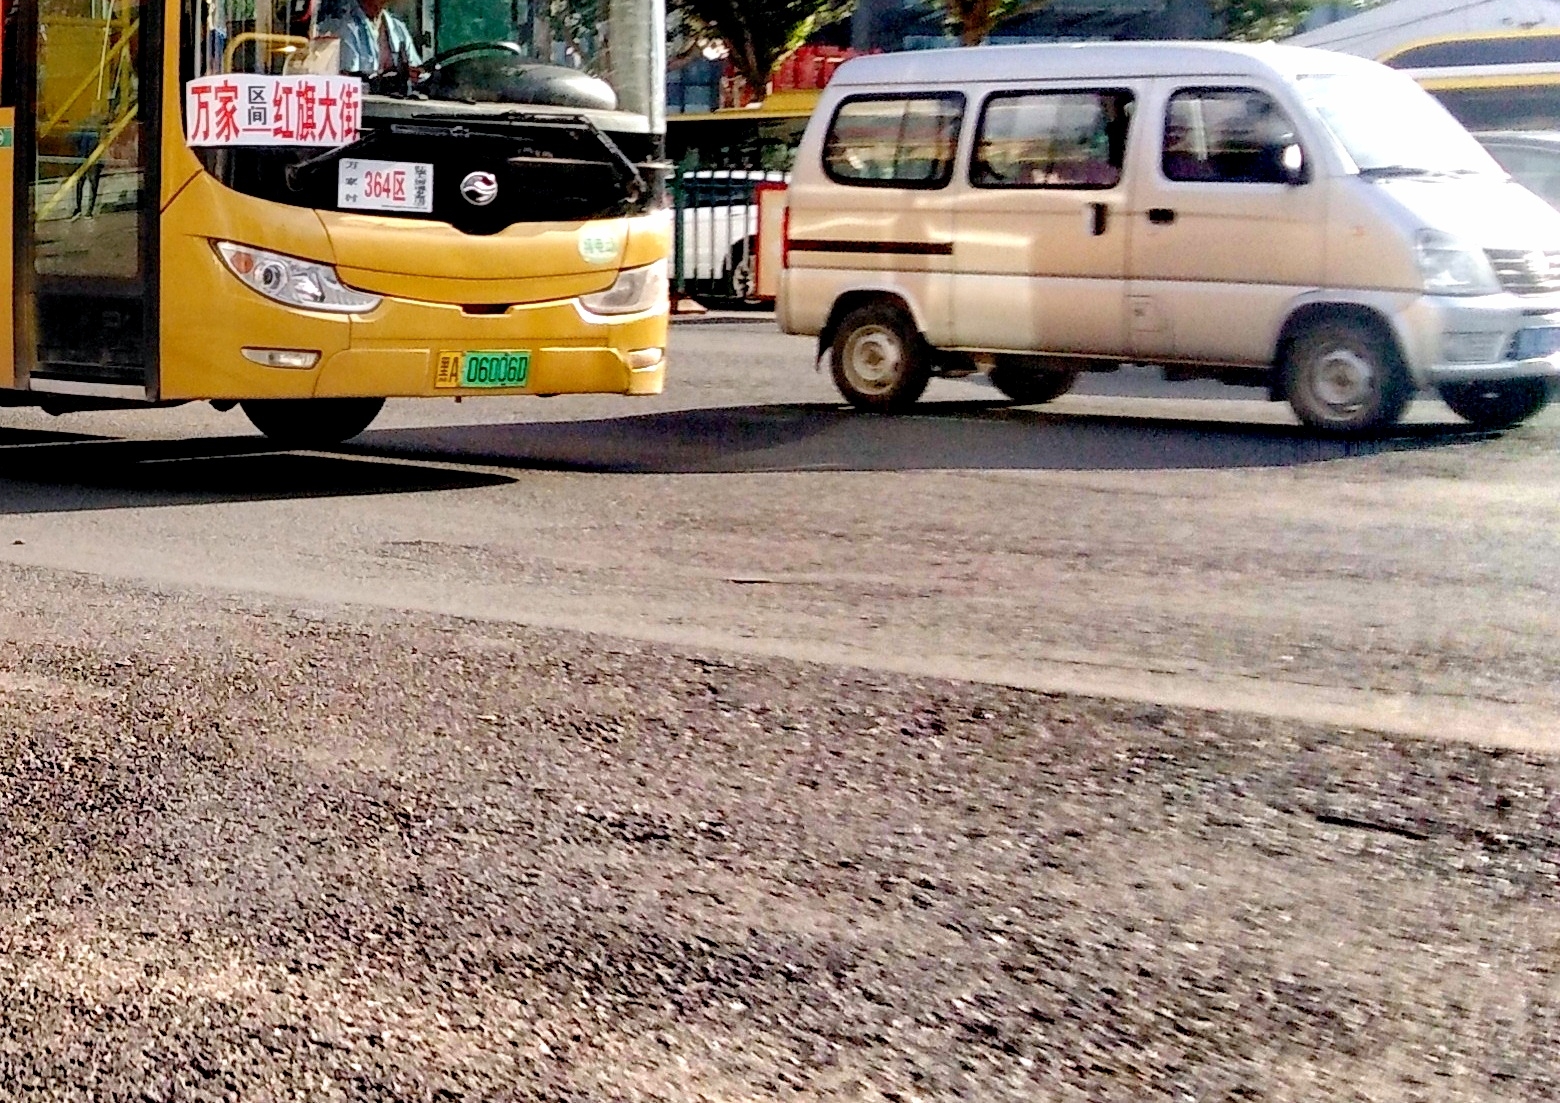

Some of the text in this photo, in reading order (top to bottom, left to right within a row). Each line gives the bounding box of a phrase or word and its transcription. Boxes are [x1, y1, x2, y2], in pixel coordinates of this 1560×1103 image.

[191, 80, 359, 143] 万家 区间 红旗大街
[364, 170, 406, 201] 364区
